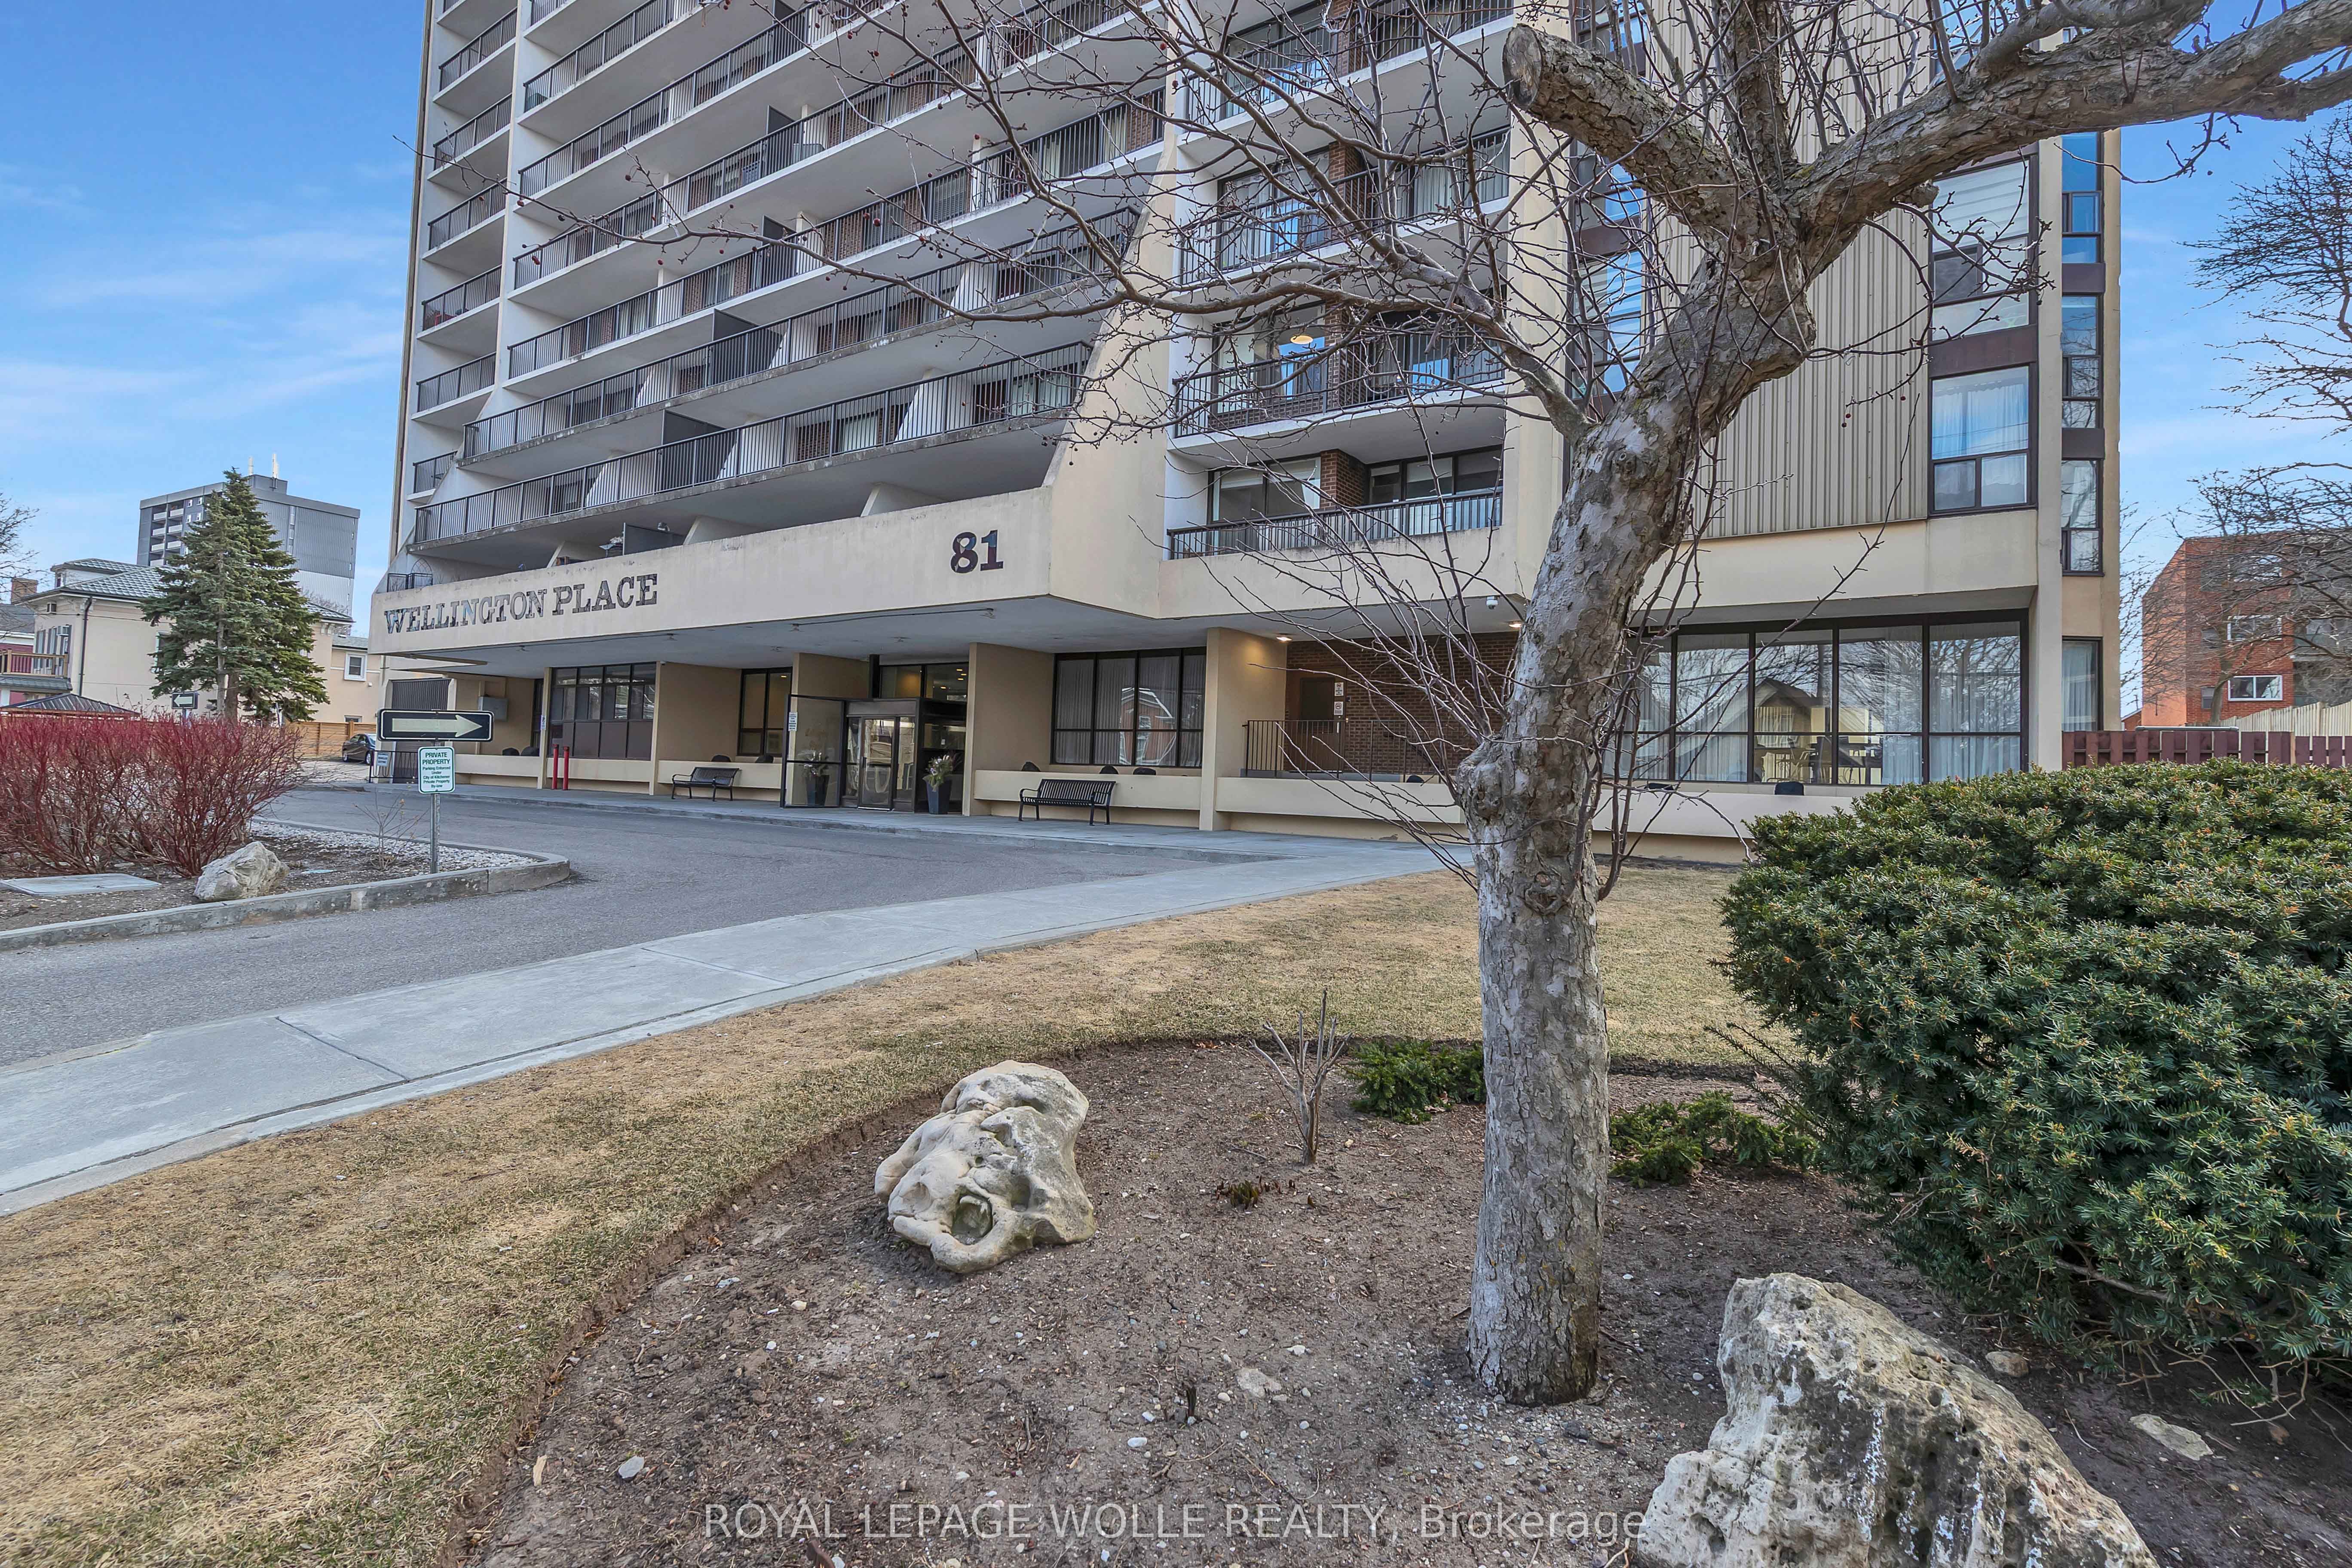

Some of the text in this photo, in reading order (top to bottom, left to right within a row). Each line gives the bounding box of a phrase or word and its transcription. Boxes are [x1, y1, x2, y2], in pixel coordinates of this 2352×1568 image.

[950, 529, 1004, 574] 81
[384, 573, 658, 634] WELLINGTON PLACE
